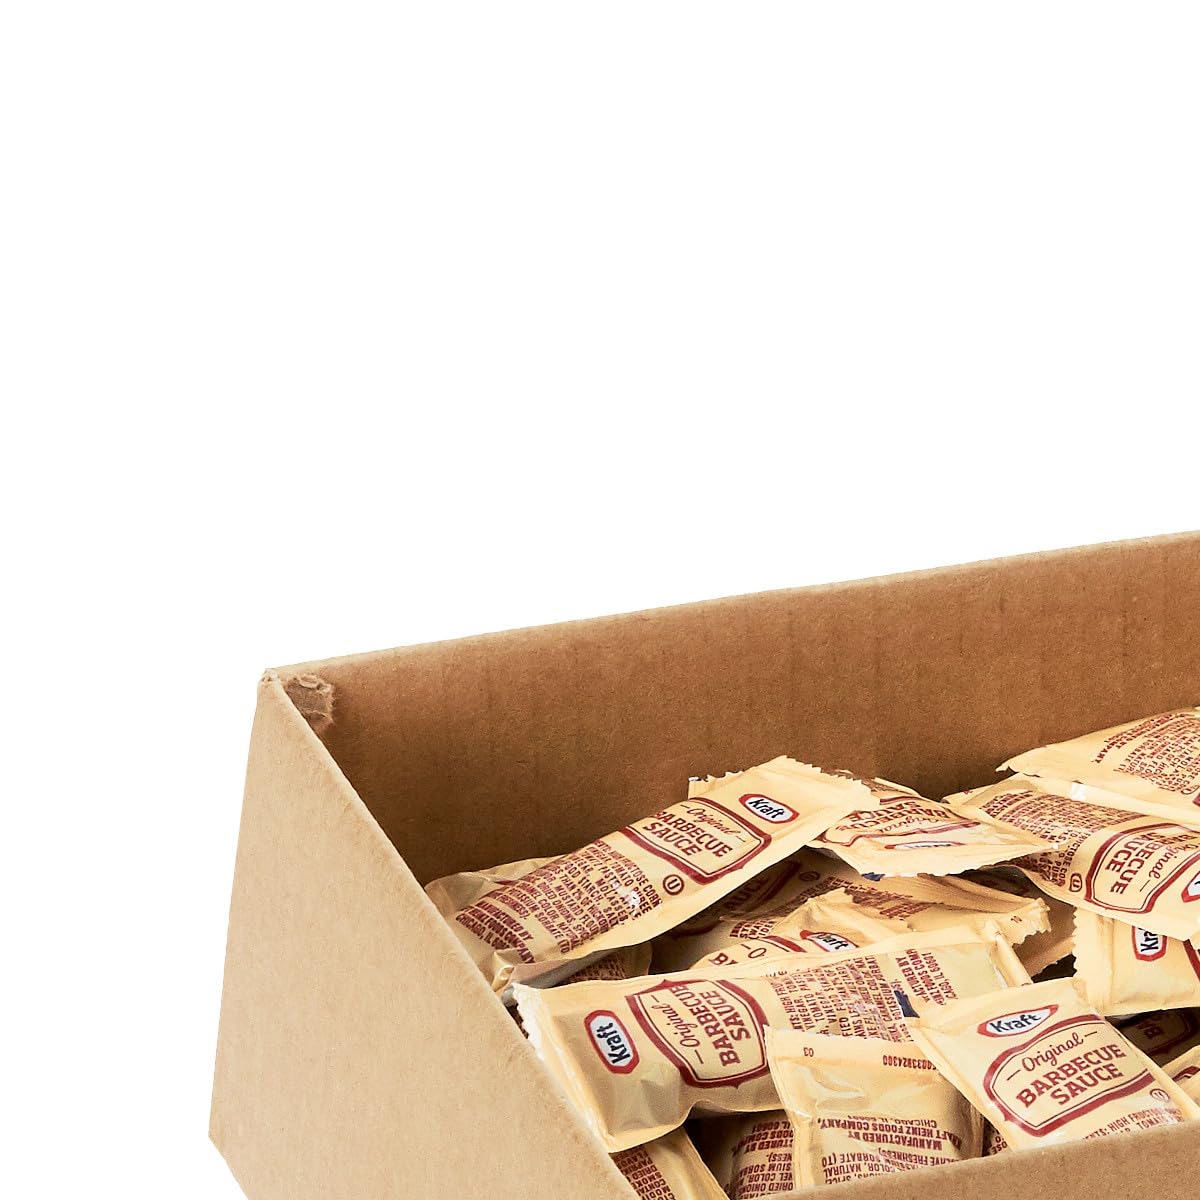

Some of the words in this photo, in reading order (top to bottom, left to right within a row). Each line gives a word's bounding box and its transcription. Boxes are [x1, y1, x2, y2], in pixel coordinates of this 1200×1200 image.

[687, 808, 741, 835] Original
[748, 799, 785, 819] Kraft
[643, 822, 703, 857] SAUCE
[1104, 832, 1167, 873] SAUCE
[1110, 833, 1198, 895] BARBECUE
[1148, 840, 1200, 880] Original
[651, 1003, 701, 1048] Original
[668, 984, 742, 1067] BARBECUE
[700, 990, 752, 1042] SAUCE
[990, 1013, 1042, 1033] Kraft
[596, 1021, 631, 1064] Kraft
[1022, 1032, 1085, 1073] Original
[1016, 1044, 1127, 1108] BARBECUE
[1050, 1063, 1124, 1106] SAUCE
[862, 1131, 943, 1151] MANUFACTURED
[872, 1120, 905, 1135] FOODS
[905, 1126, 934, 1139] HEINZ
[1107, 1116, 1130, 1132] HIGH
